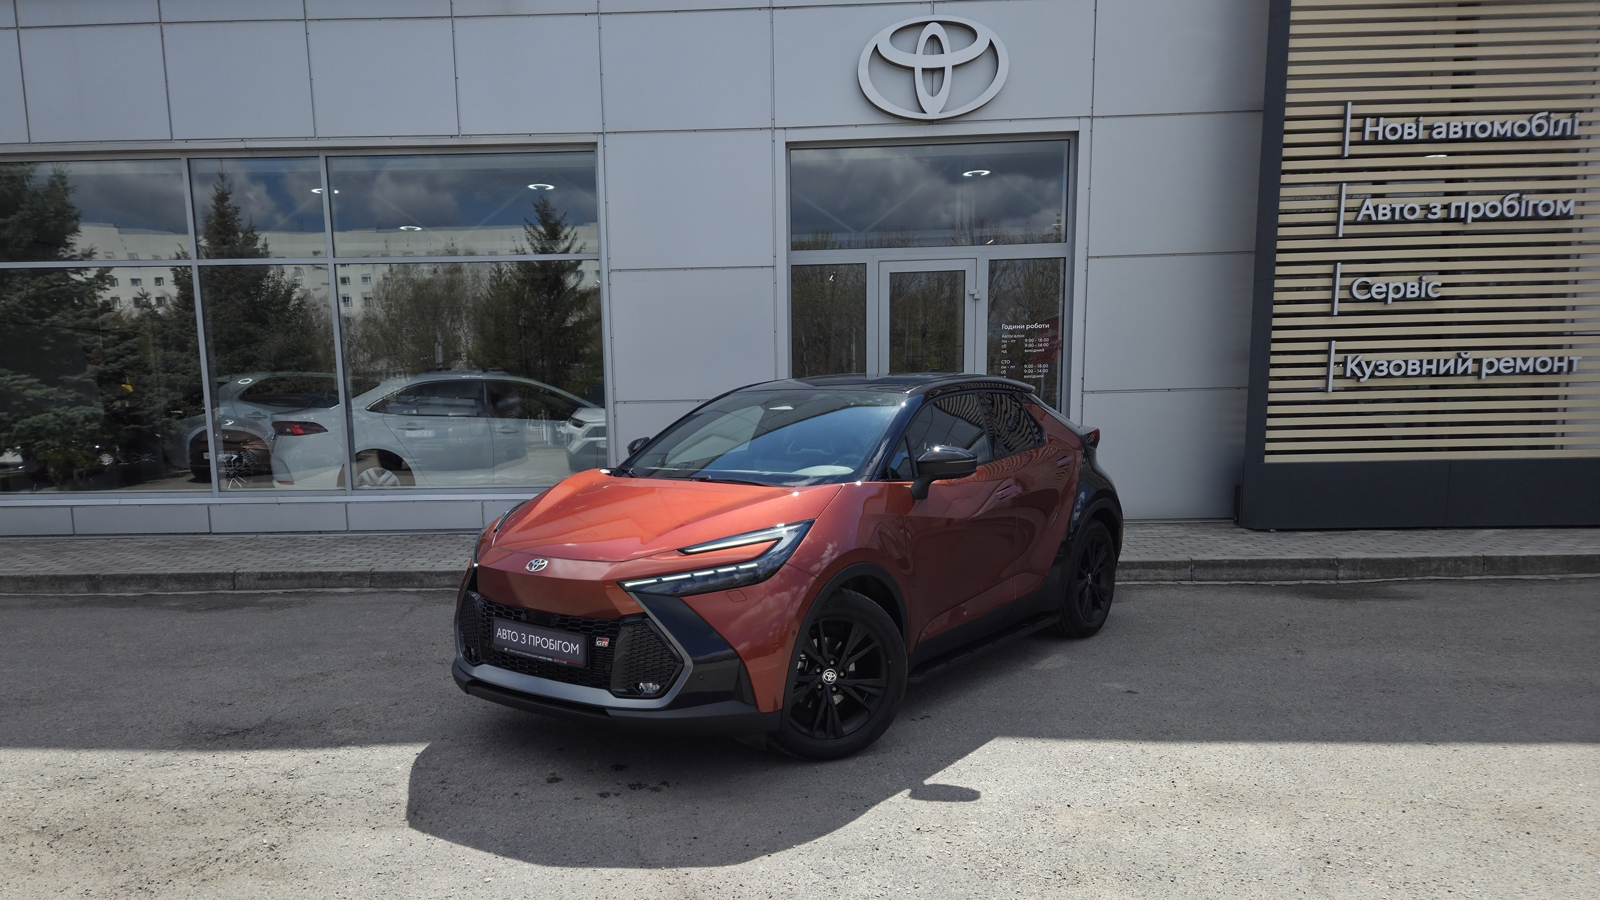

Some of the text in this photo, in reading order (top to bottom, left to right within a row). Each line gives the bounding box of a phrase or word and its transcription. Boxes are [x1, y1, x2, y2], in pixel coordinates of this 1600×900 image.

[1363, 111, 1580, 141] Нові автомобілі
[1356, 192, 1575, 223] Авто з пробігом
[1351, 275, 1442, 304] Сервіс
[1025, 322, 1050, 330] роботи
[1345, 352, 1582, 382] Кузовний ремонт
[496, 627, 519, 643] АВТО
[520, 632, 527, 645] З
[528, 634, 580, 655] ПРОБІГОМ
